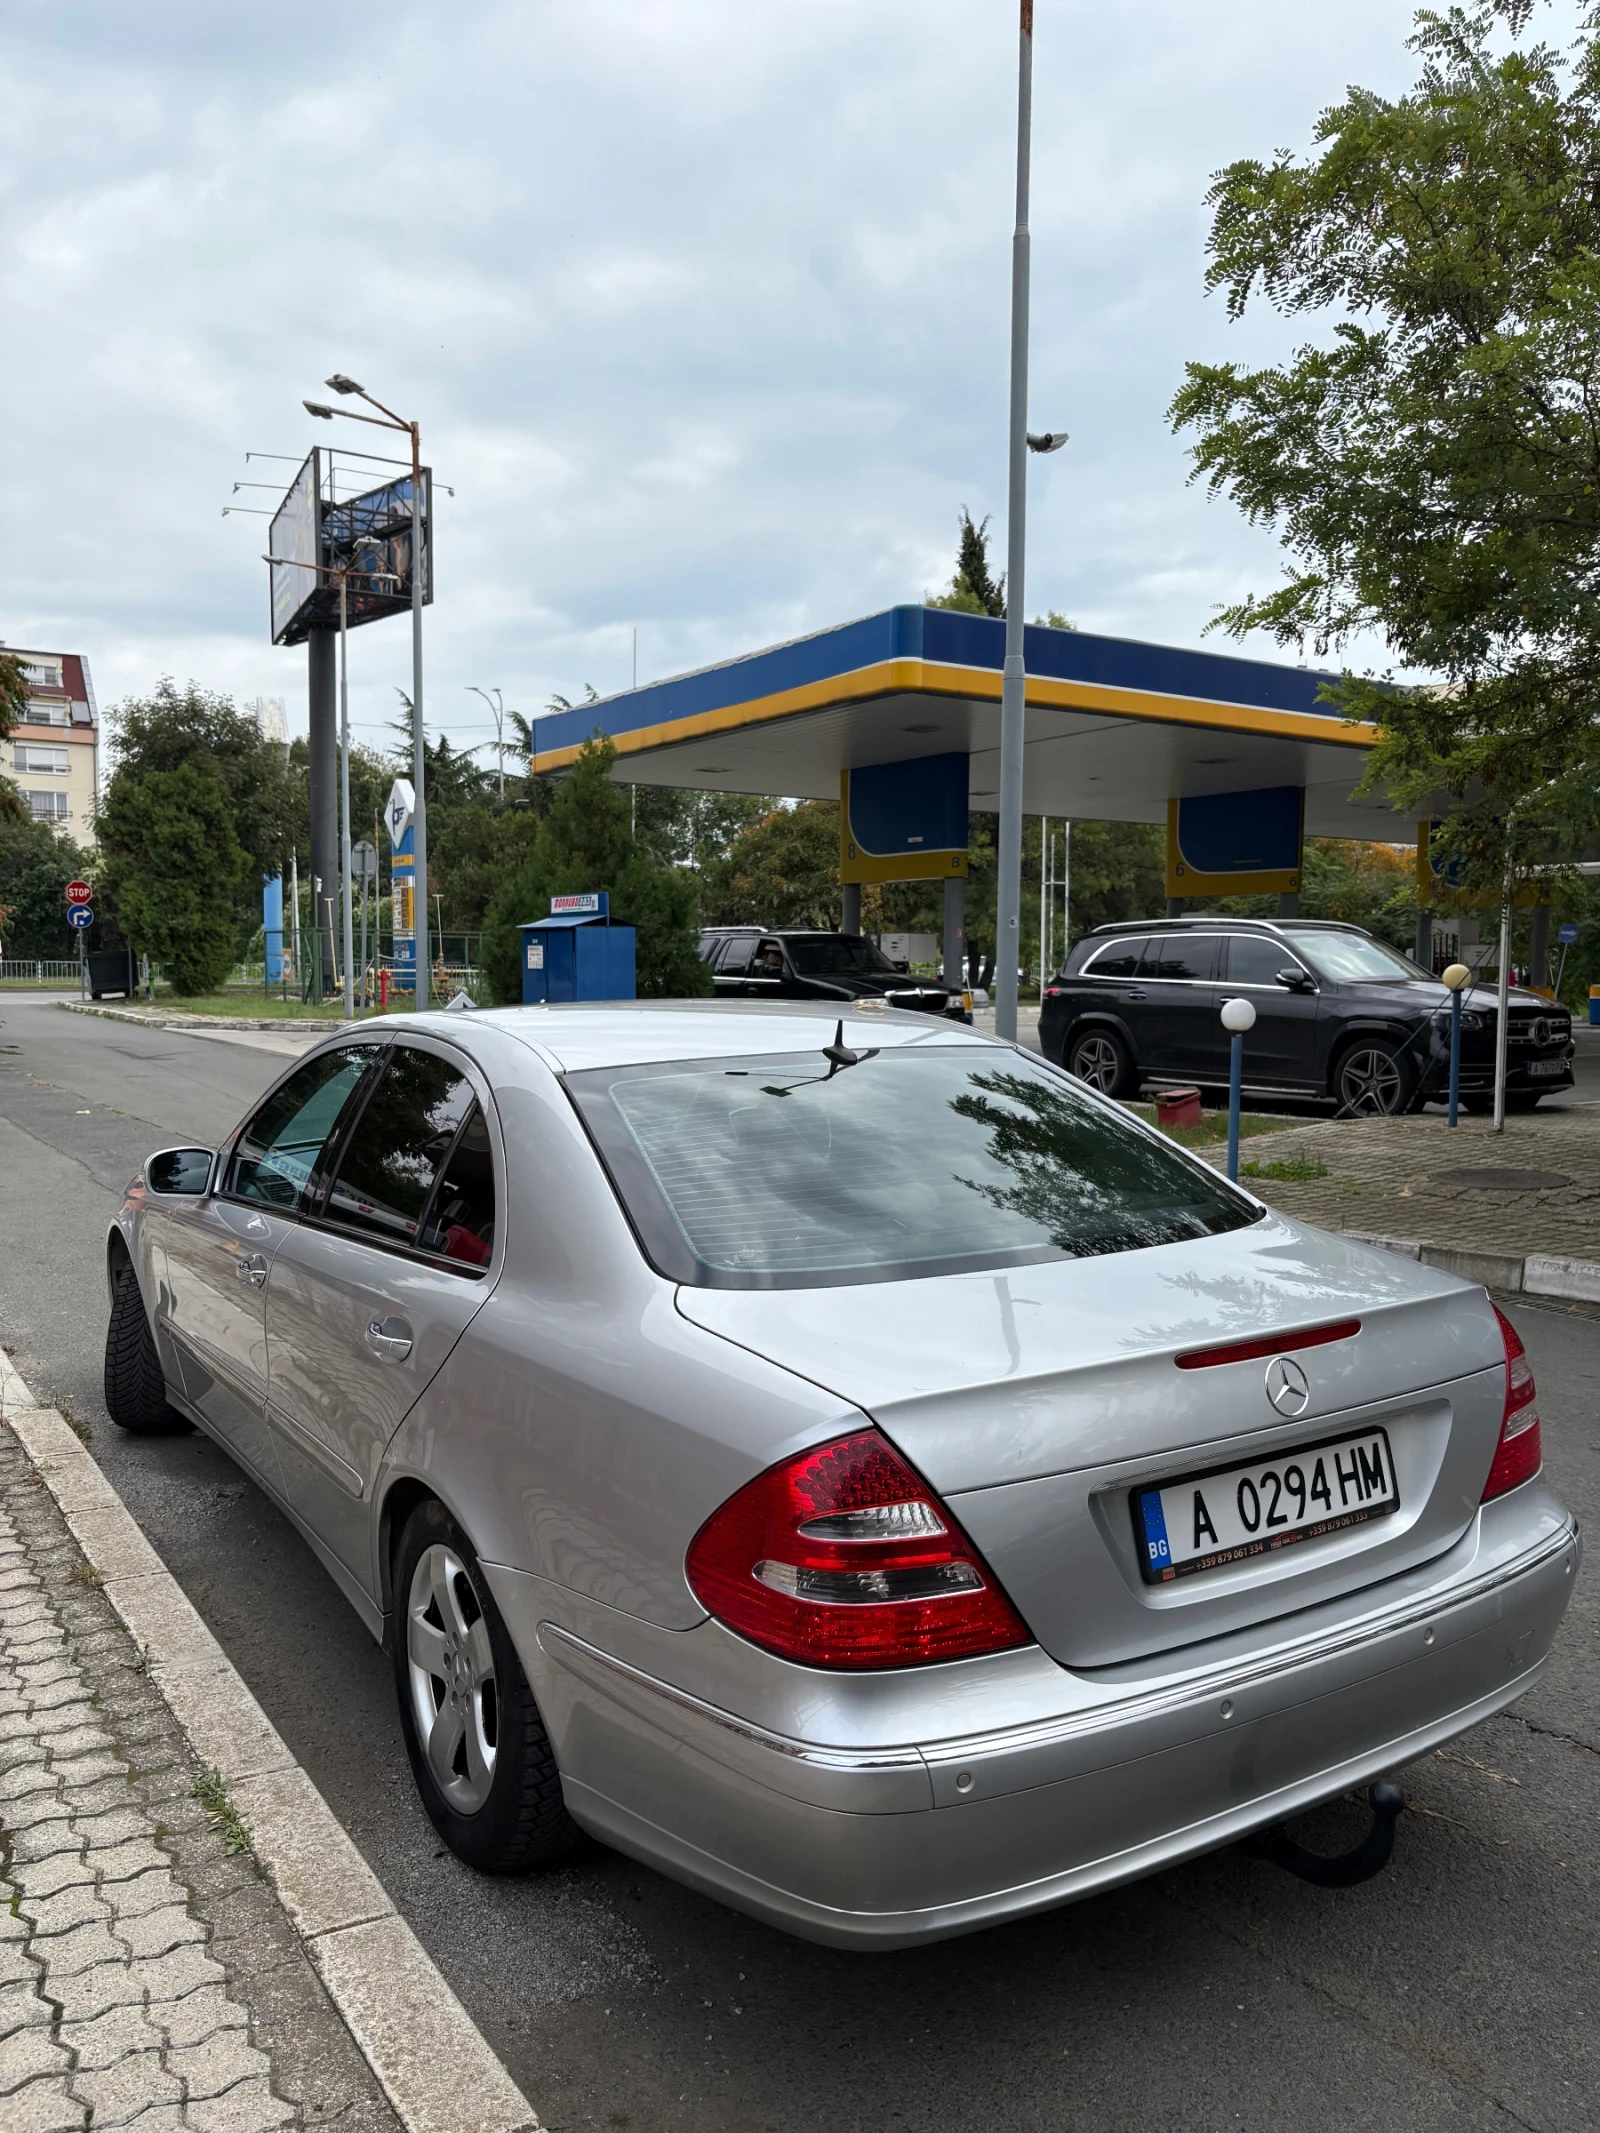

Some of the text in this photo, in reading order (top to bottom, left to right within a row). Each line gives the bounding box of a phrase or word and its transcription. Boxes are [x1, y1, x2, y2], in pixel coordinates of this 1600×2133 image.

[951, 856, 960, 868] 8
[1176, 862, 1185, 877] 6
[1289, 877, 1297, 887] 6
[68, 888, 90, 897] STOP
[1193, 1489, 1218, 1549] A
[1308, 1523, 1326, 1537] +359
[1341, 1514, 1354, 1526] 061
[1148, 1539, 1168, 1560] BG
[1196, 1556, 1216, 1569] +359
[1217, 1551, 1232, 1564] 879
[1233, 1547, 1248, 1559] 061
[1249, 1542, 1264, 1554] 334
